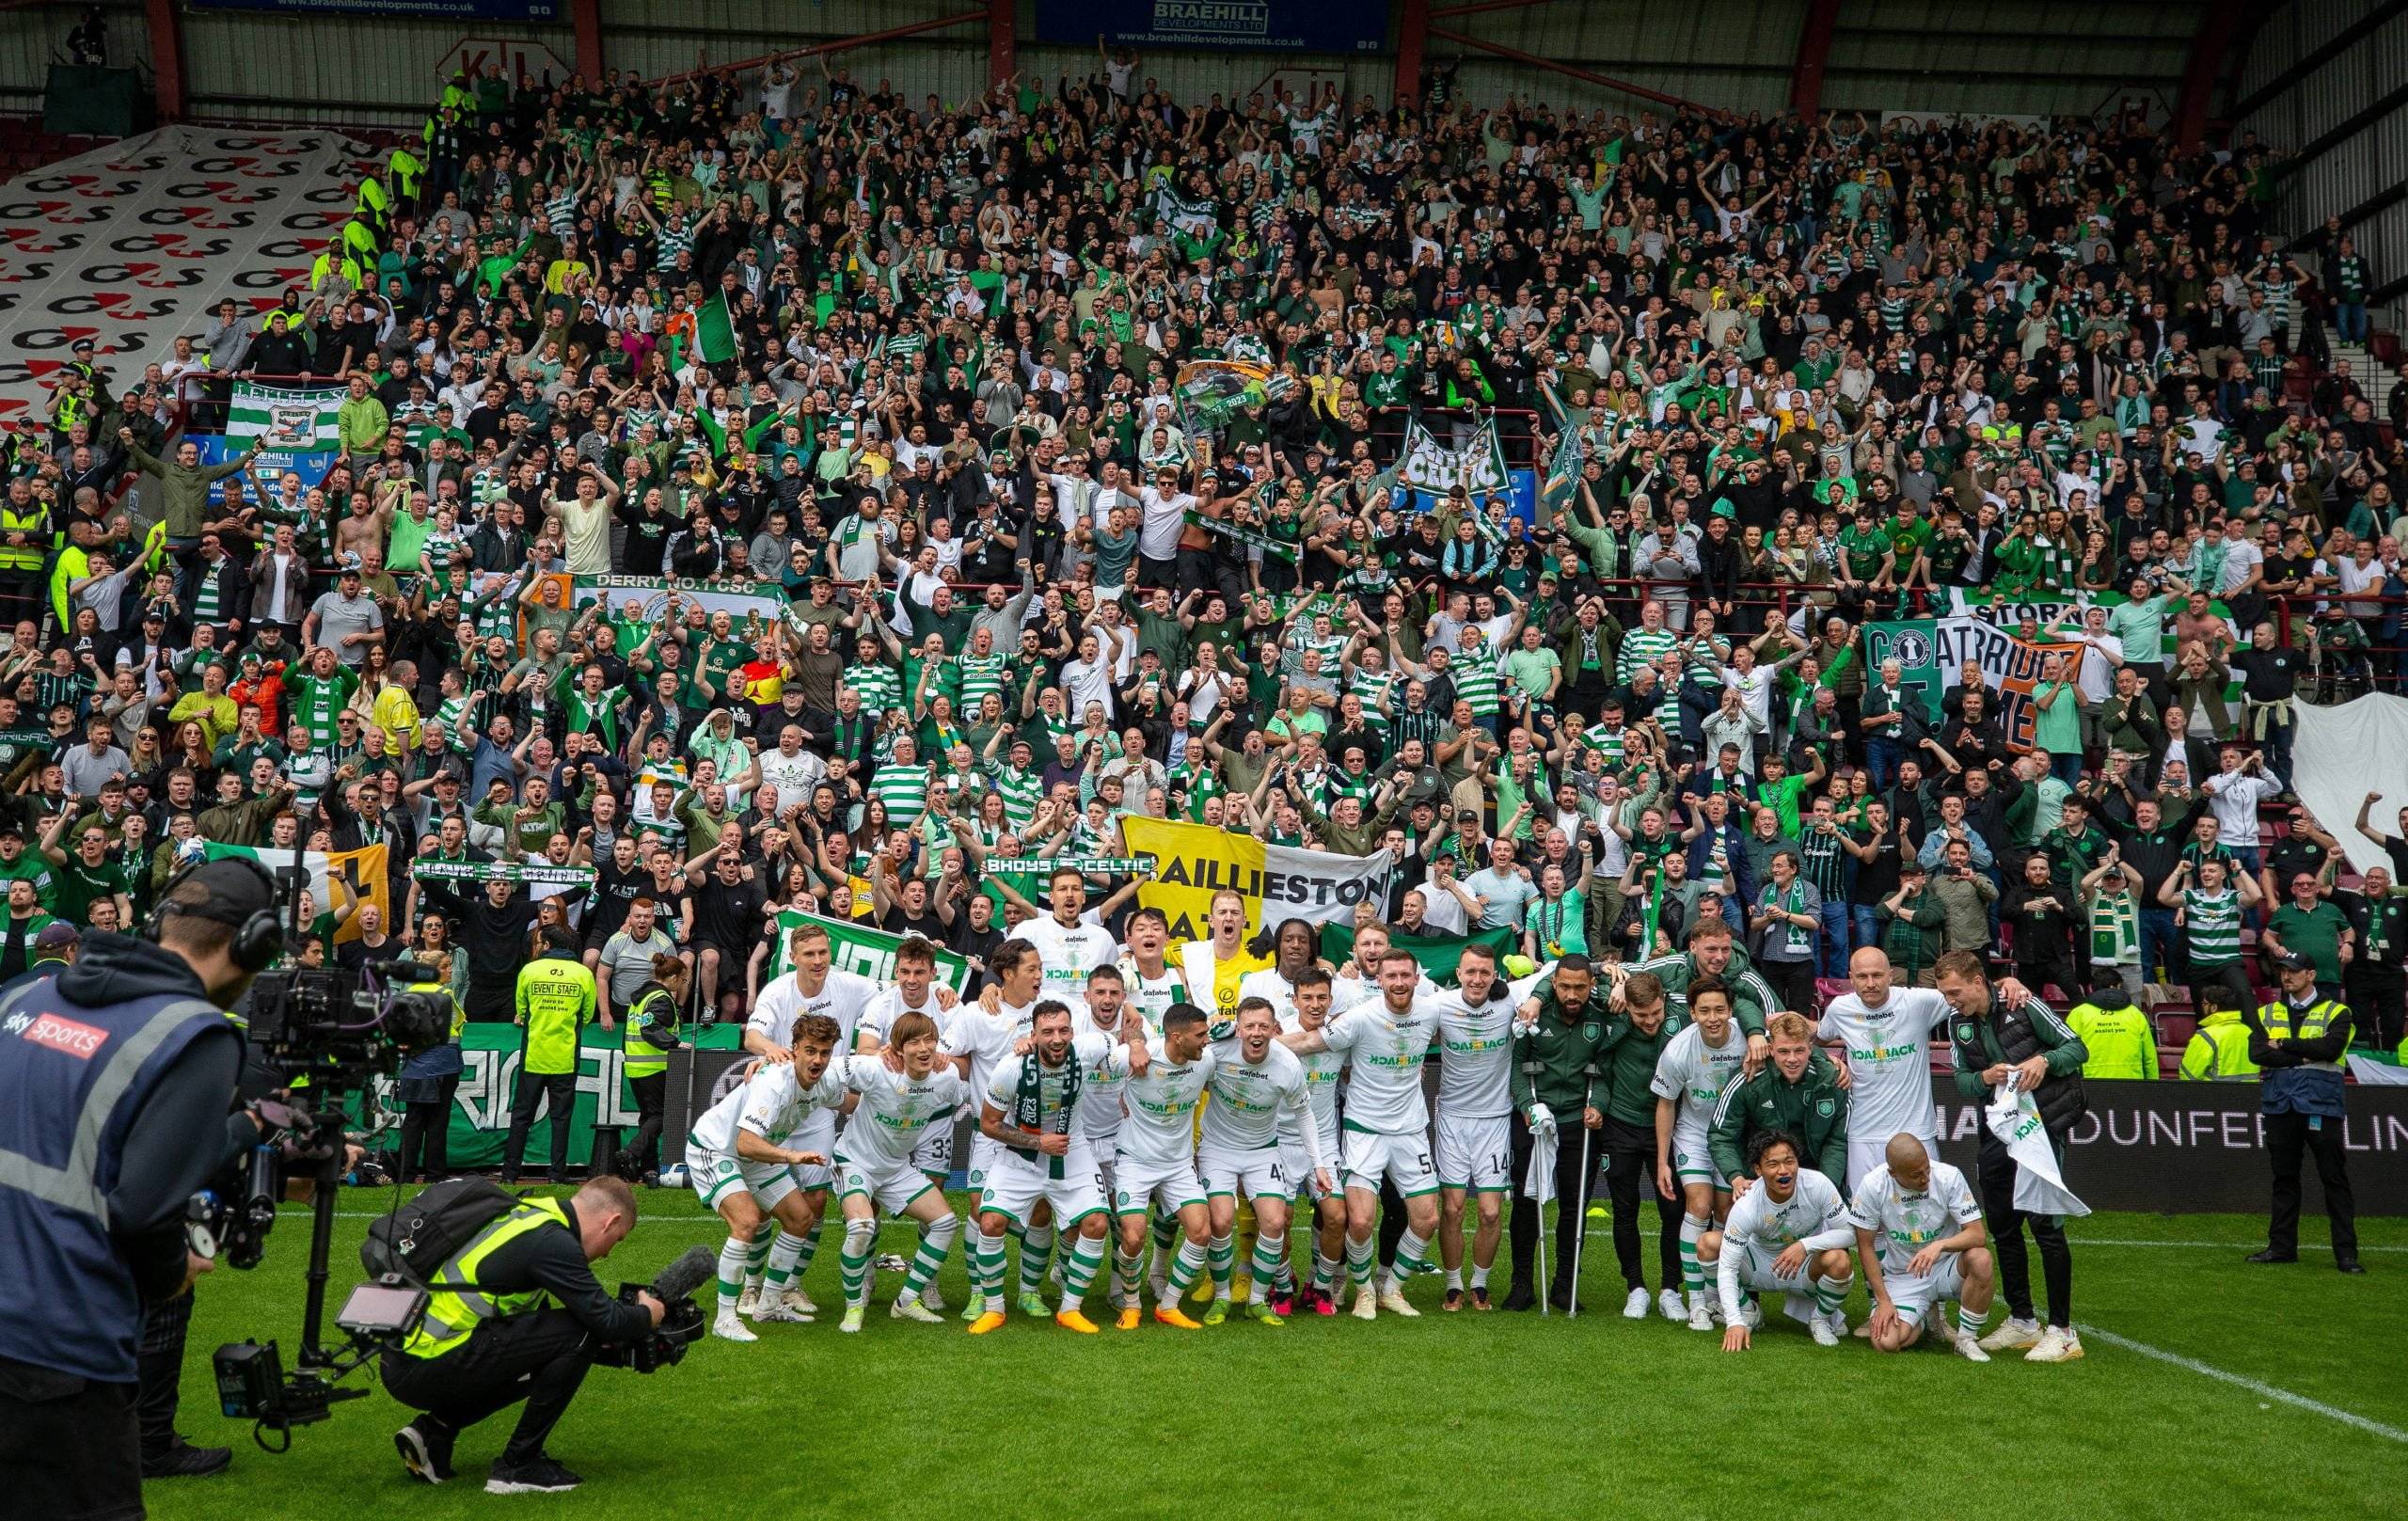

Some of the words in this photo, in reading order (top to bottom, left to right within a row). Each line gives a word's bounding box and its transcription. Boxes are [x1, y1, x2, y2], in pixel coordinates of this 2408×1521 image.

[1154, 1, 1265, 20] BRAEHILL
[1152, 19, 1242, 30] DEVELOPMENTS
[1243, 20, 1263, 30] LTD
[110, 233, 232, 258] G4S
[79, 262, 207, 288] G4S
[47, 293, 180, 320] G4S
[237, 385, 308, 404] LEITH
[596, 574, 659, 590] DERRY
[669, 577, 709, 591] NO.1
[717, 578, 756, 594] CSC
[988, 859, 1052, 872] BHOYS
[1084, 859, 1151, 873] CELTIC
[1065, 935, 1088, 943] dafabet
[533, 983, 555, 994] EVENT
[557, 984, 578, 995] STAFF
[1143, 989, 1171, 998] dafabet
[1017, 1016, 1035, 1027] dafab
[1865, 1011, 1895, 1022] dafabet
[3, 1010, 37, 1035] sky
[31, 1019, 99, 1052] sports
[1396, 1020, 1422, 1029] dafabet
[1710, 1054, 1741, 1063] dafabet
[1239, 1069, 1269, 1081] dafabet
[908, 1085, 934, 1095] dafabet
[745, 1114, 769, 1134] dafabet
[1057, 1106, 1069, 1133] 2023
[1095, 1173, 1107, 1195] 9
